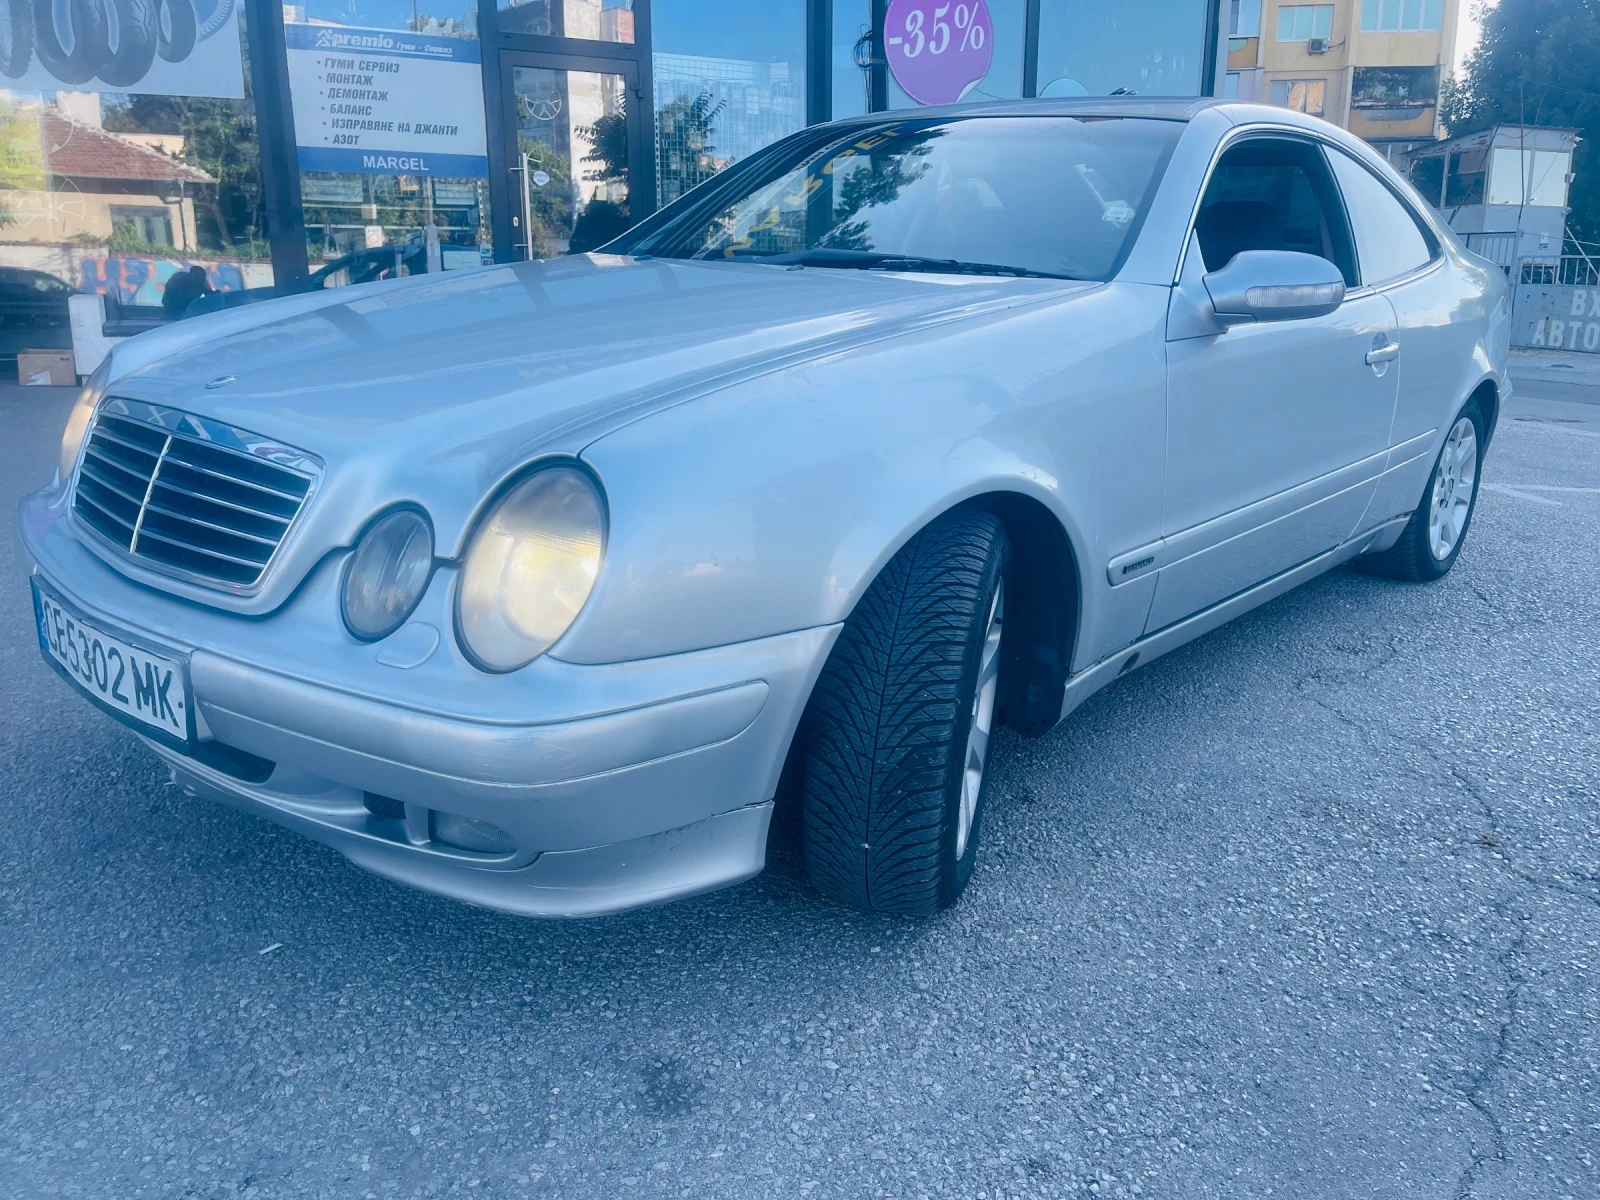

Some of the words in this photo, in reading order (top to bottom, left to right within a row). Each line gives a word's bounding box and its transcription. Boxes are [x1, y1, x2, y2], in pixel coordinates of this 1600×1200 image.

[888, 1, 985, 58] -35%
[331, 33, 394, 51] premio
[324, 57, 354, 70] ГУМИ
[358, 60, 400, 73] СЕРВИЗ
[326, 73, 374, 86] МОНТАЖ
[327, 88, 389, 101] ДЕМОНТАЖ
[329, 104, 372, 116] БАЛАНС
[331, 118, 394, 132] ИЗПРАВЯНЕ
[397, 122, 411, 133] НА
[414, 124, 458, 136] ДЖАНТИ
[332, 134, 360, 145] АЗОТ
[362, 155, 430, 171] MARGEL
[1531, 319, 1600, 350] АВТО
